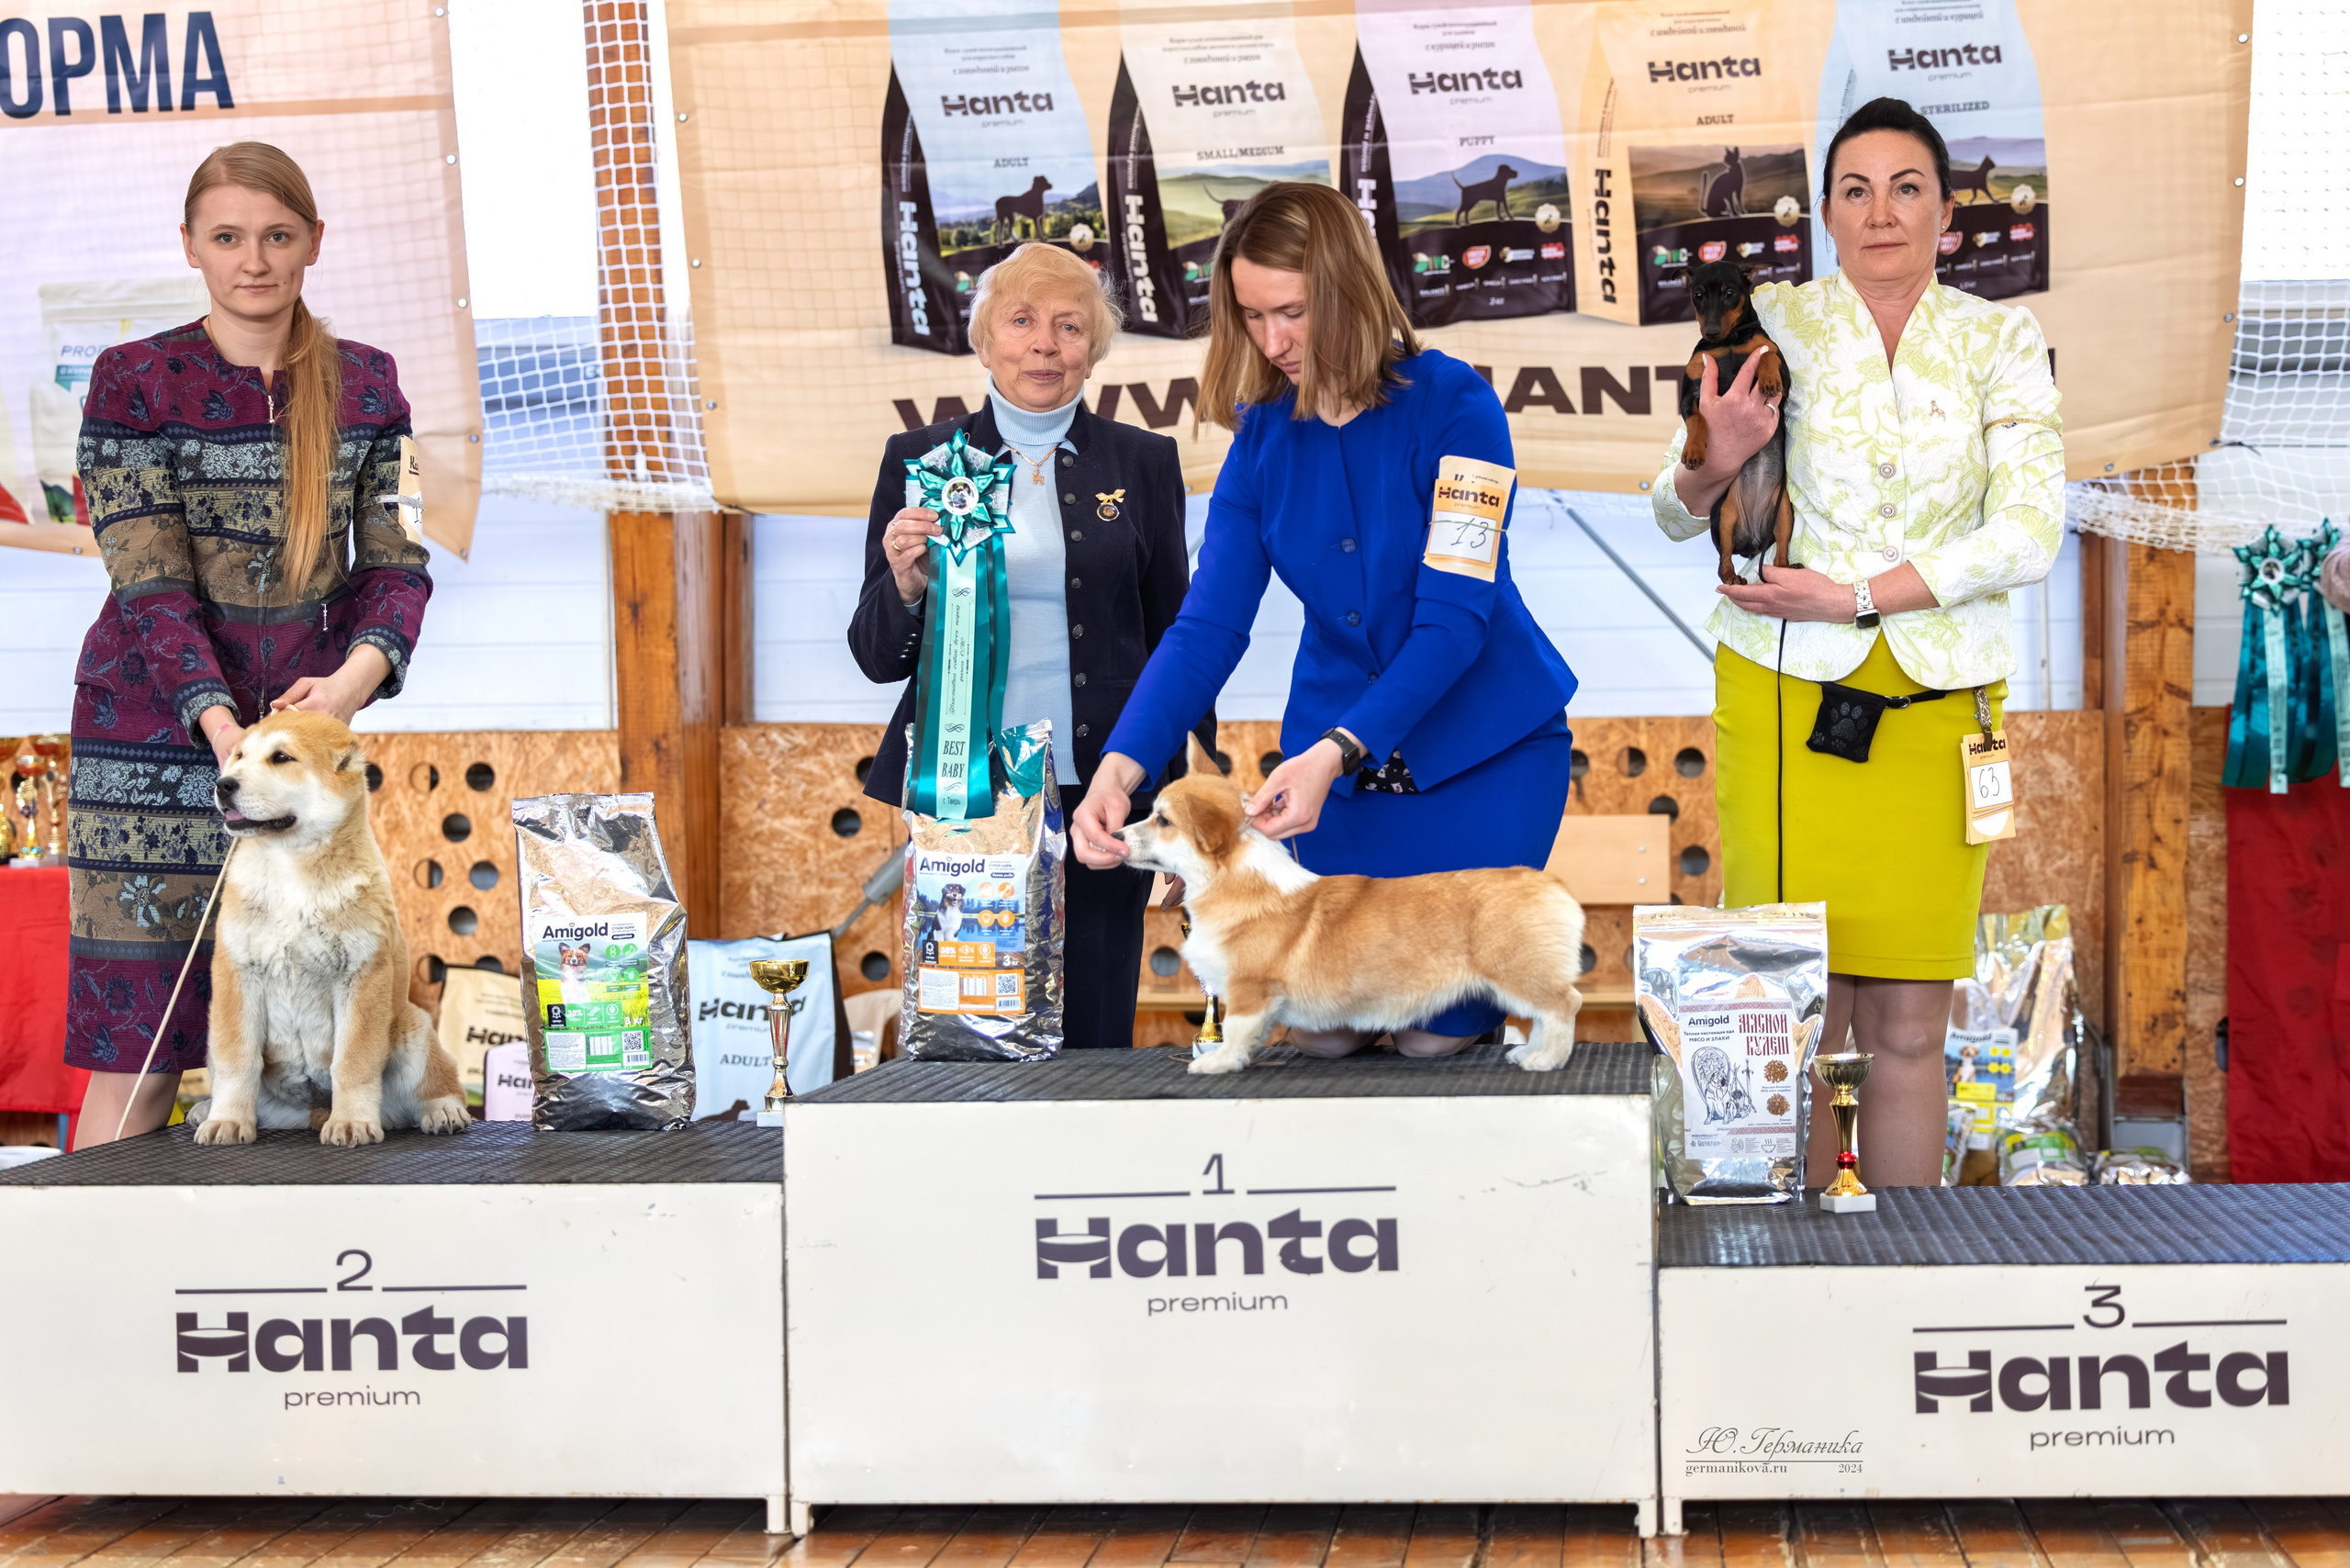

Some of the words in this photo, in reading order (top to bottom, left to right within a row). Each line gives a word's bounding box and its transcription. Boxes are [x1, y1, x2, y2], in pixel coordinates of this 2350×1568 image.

[0, 11, 235, 119] ОРМА
[1648, 55, 1762, 83] Hanta
[1888, 43, 2002, 71] Hanta
[1172, 79, 1286, 107] Hanta
[1408, 67, 1523, 95] Hanta
[941, 90, 1054, 117] Hanta
[1919, 100, 1990, 116] STERILIZED
[1696, 113, 1734, 126] ADULT
[1196, 145, 1285, 162] SMALL/MEDIUM
[1460, 135, 1495, 147] PUPPY
[994, 157, 1030, 169] ADULT
[1595, 169, 1617, 304] Hanta
[899, 201, 931, 336] Hanta
[1125, 195, 1158, 322] Hanta
[1438, 487, 1500, 508] Hanta
[1450, 518, 1489, 548] 13
[943, 740, 966, 756] BEST
[941, 762, 965, 778] BABY
[1979, 767, 2000, 799] 63
[947, 797, 961, 806] Тверь
[919, 857, 985, 877] Amigold
[543, 922, 609, 942] Amigold
[1003, 955, 1011, 967] 3
[567, 1009, 583, 1017] 38%
[699, 997, 806, 1021] Hana
[1688, 1015, 1729, 1026] Amigold
[1739, 1012, 1788, 1035] МЯСНОЙ
[1746, 1036, 1789, 1056] КУЛЕШ
[720, 1054, 771, 1067] ADULT
[1203, 1153, 1235, 1194] 1
[1035, 1207, 1399, 1279] Hanta
[336, 1249, 374, 1291] 2
[1147, 1291, 1289, 1316] premium
[2083, 1284, 2126, 1328] 3
[176, 1305, 529, 1372] Hanta
[1914, 1340, 2290, 1414] Hanta
[285, 1385, 421, 1410] premium
[2030, 1426, 2176, 1451] premium
